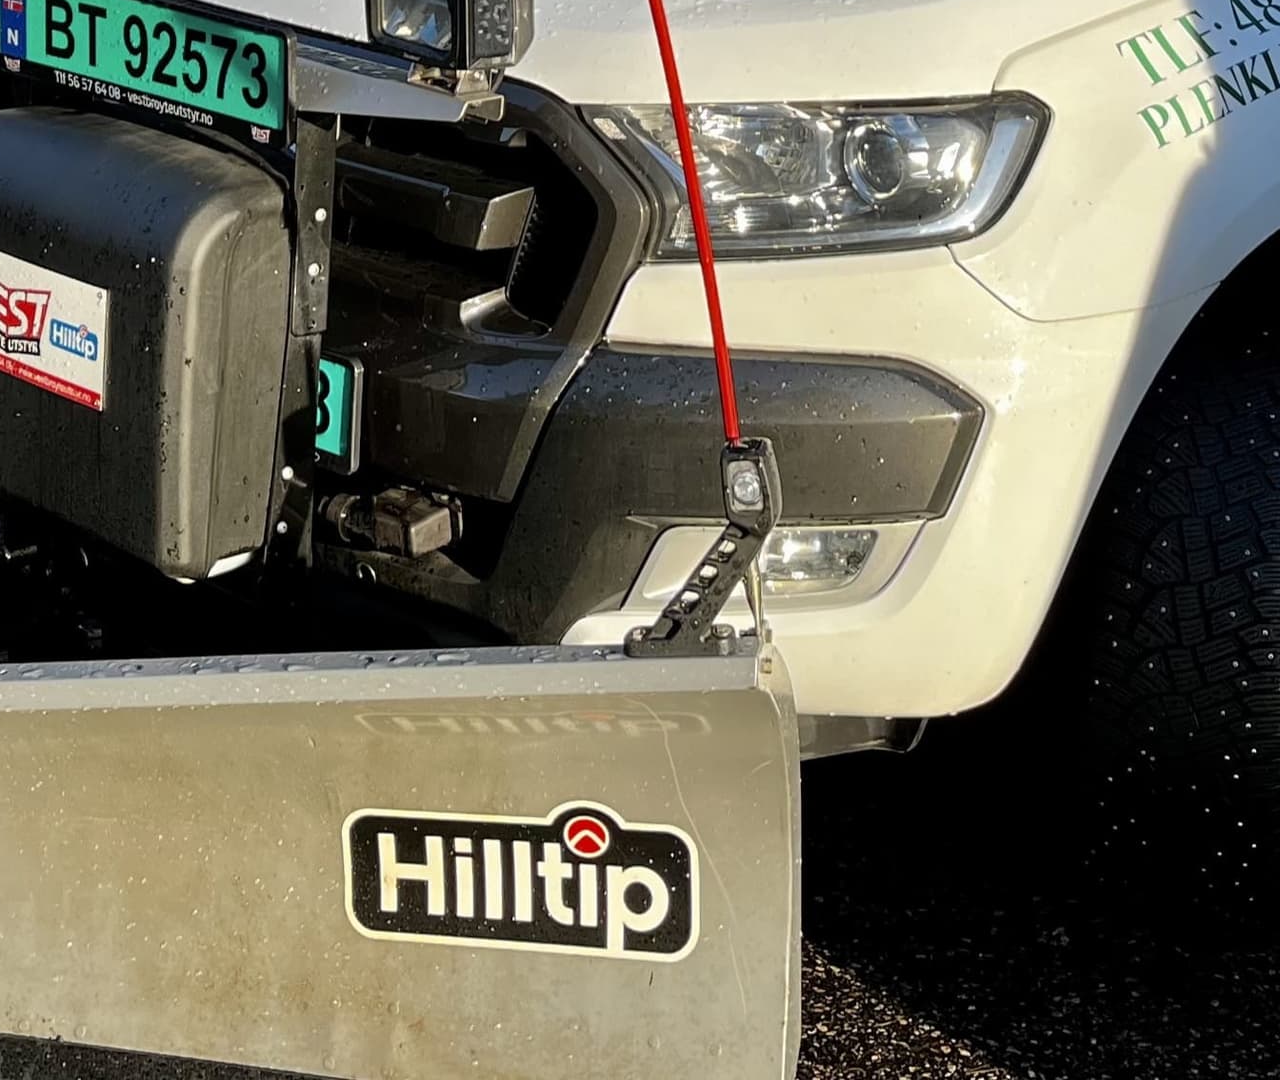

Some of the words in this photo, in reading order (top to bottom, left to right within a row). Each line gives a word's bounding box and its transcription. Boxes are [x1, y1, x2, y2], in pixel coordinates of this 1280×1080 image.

[7, 27, 19, 47] N
[122, 14, 269, 109] 92573
[1115, 8, 1238, 87] TLF:
[67, 74, 81, 89] 56
[82, 78, 93, 92] 57
[94, 82, 107, 96] 64
[52, 322, 97, 360] Hilltip
[377, 831, 670, 951] Hilltip
